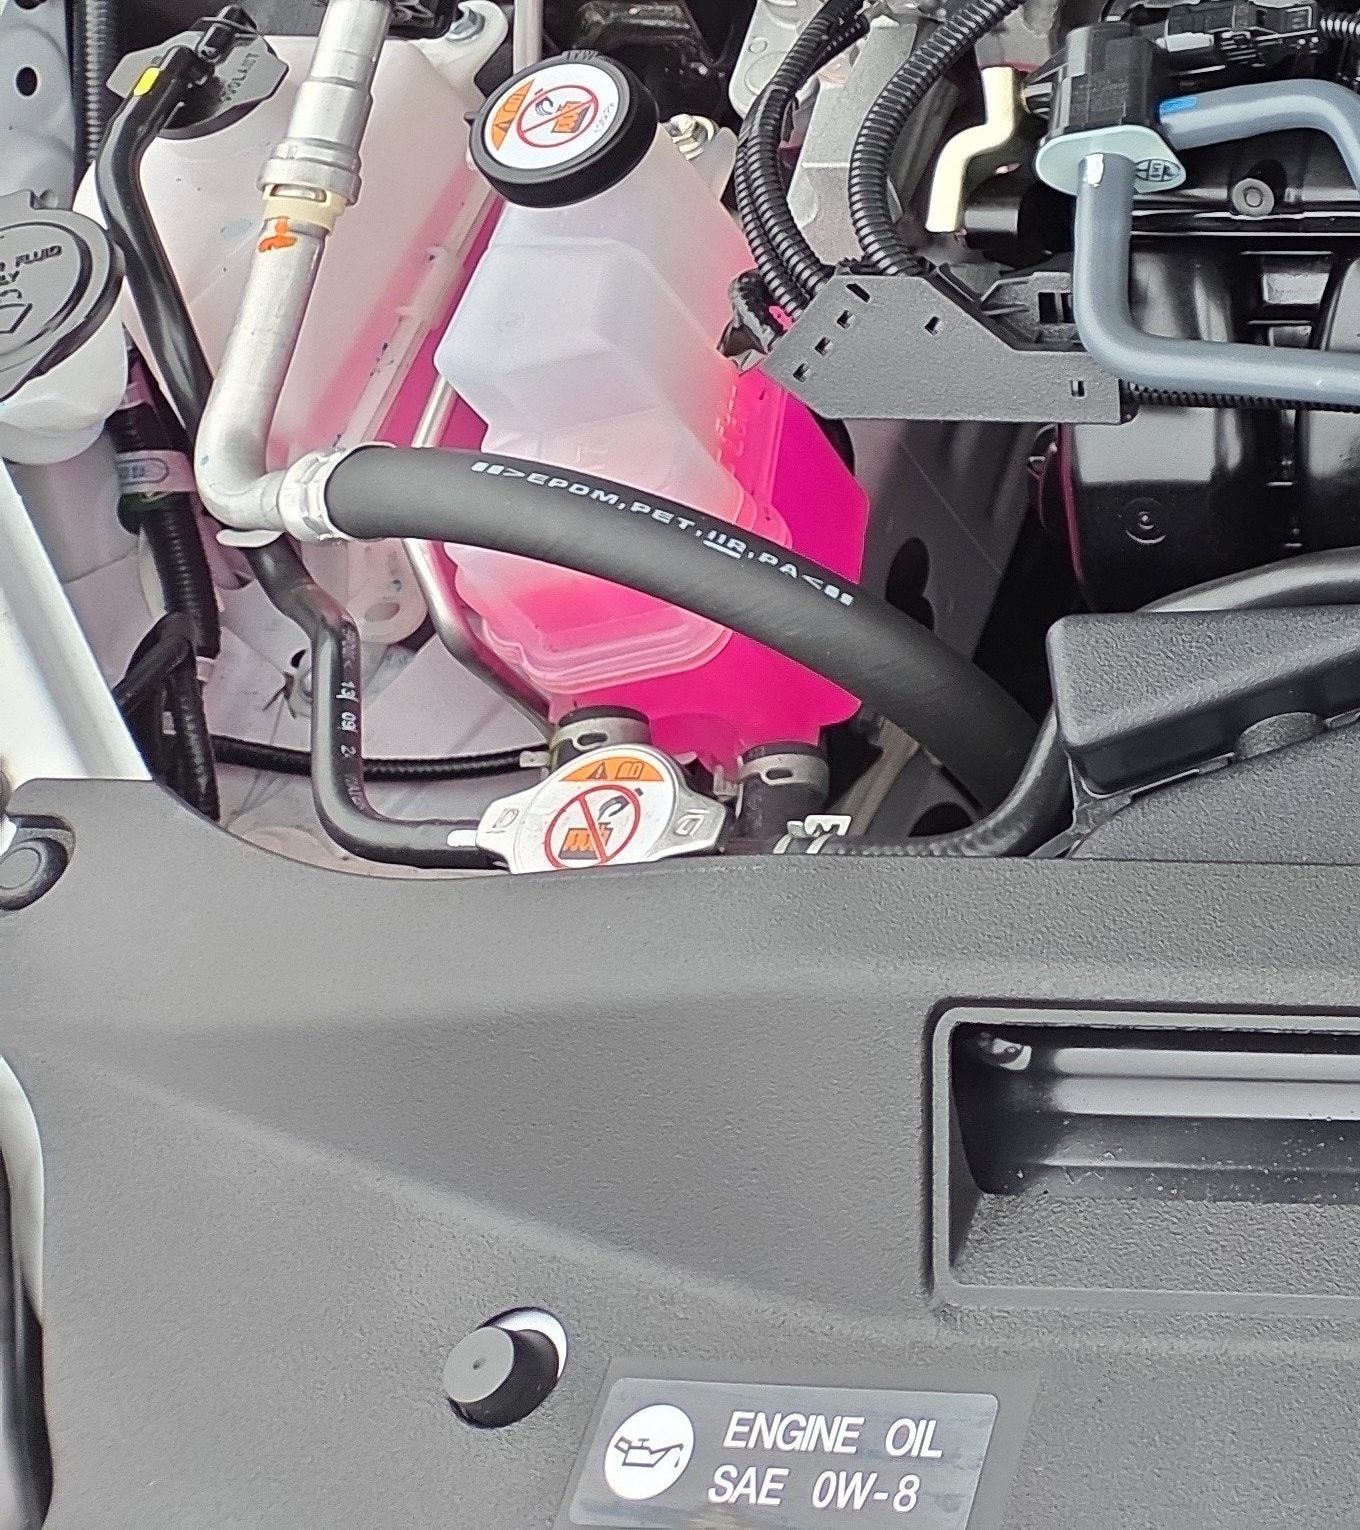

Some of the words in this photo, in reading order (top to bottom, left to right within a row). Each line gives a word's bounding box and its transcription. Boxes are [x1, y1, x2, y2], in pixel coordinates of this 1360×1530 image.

[15, 244, 63, 269] FLUID
[722, 1409, 865, 1455] ENGINE
[885, 1418, 944, 1459] OIL
[708, 1464, 790, 1507] SAE
[811, 1470, 921, 1514] 0W-8
